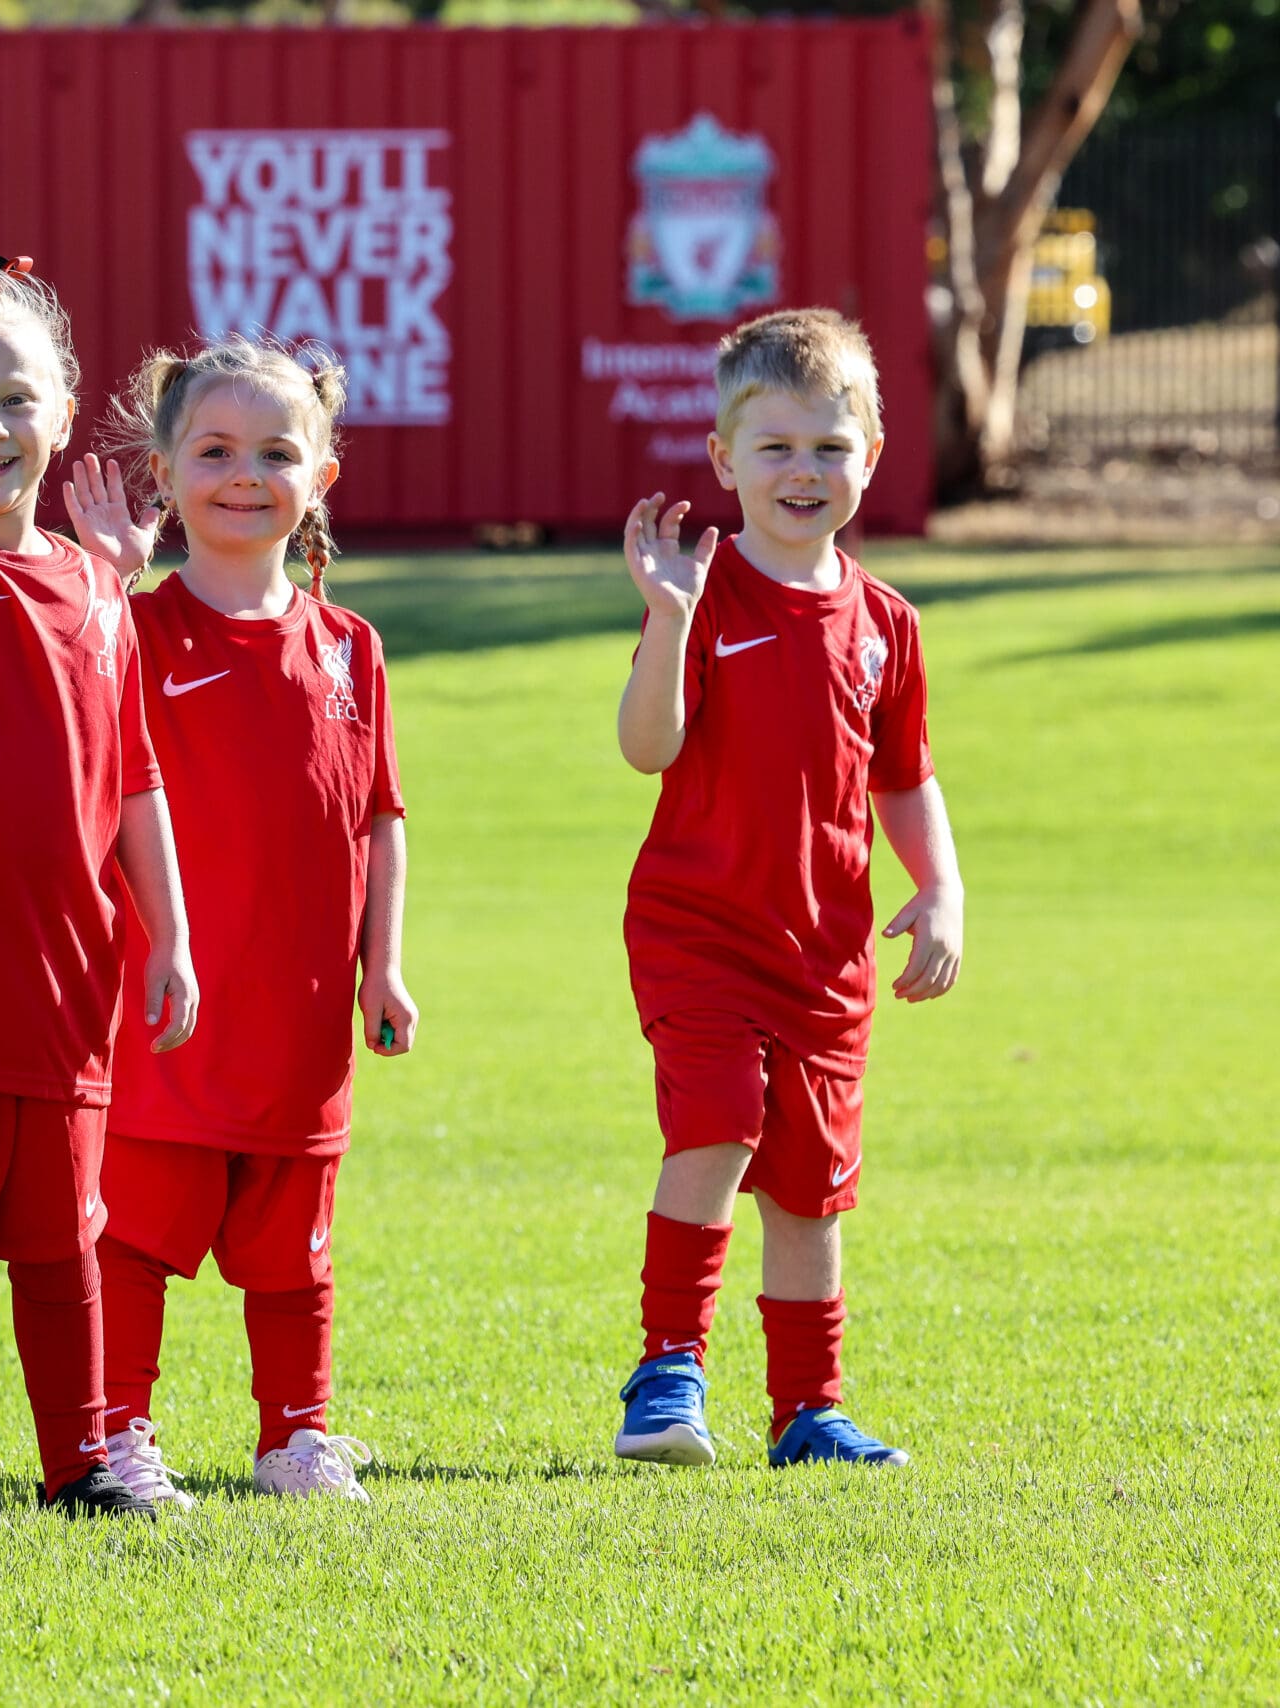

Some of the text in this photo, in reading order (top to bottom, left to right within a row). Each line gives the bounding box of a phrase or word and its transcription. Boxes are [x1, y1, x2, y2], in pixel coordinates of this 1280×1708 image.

[186, 134, 451, 206] YOU'LL
[188, 204, 452, 274] NEVER
[190, 272, 452, 350] WALK
